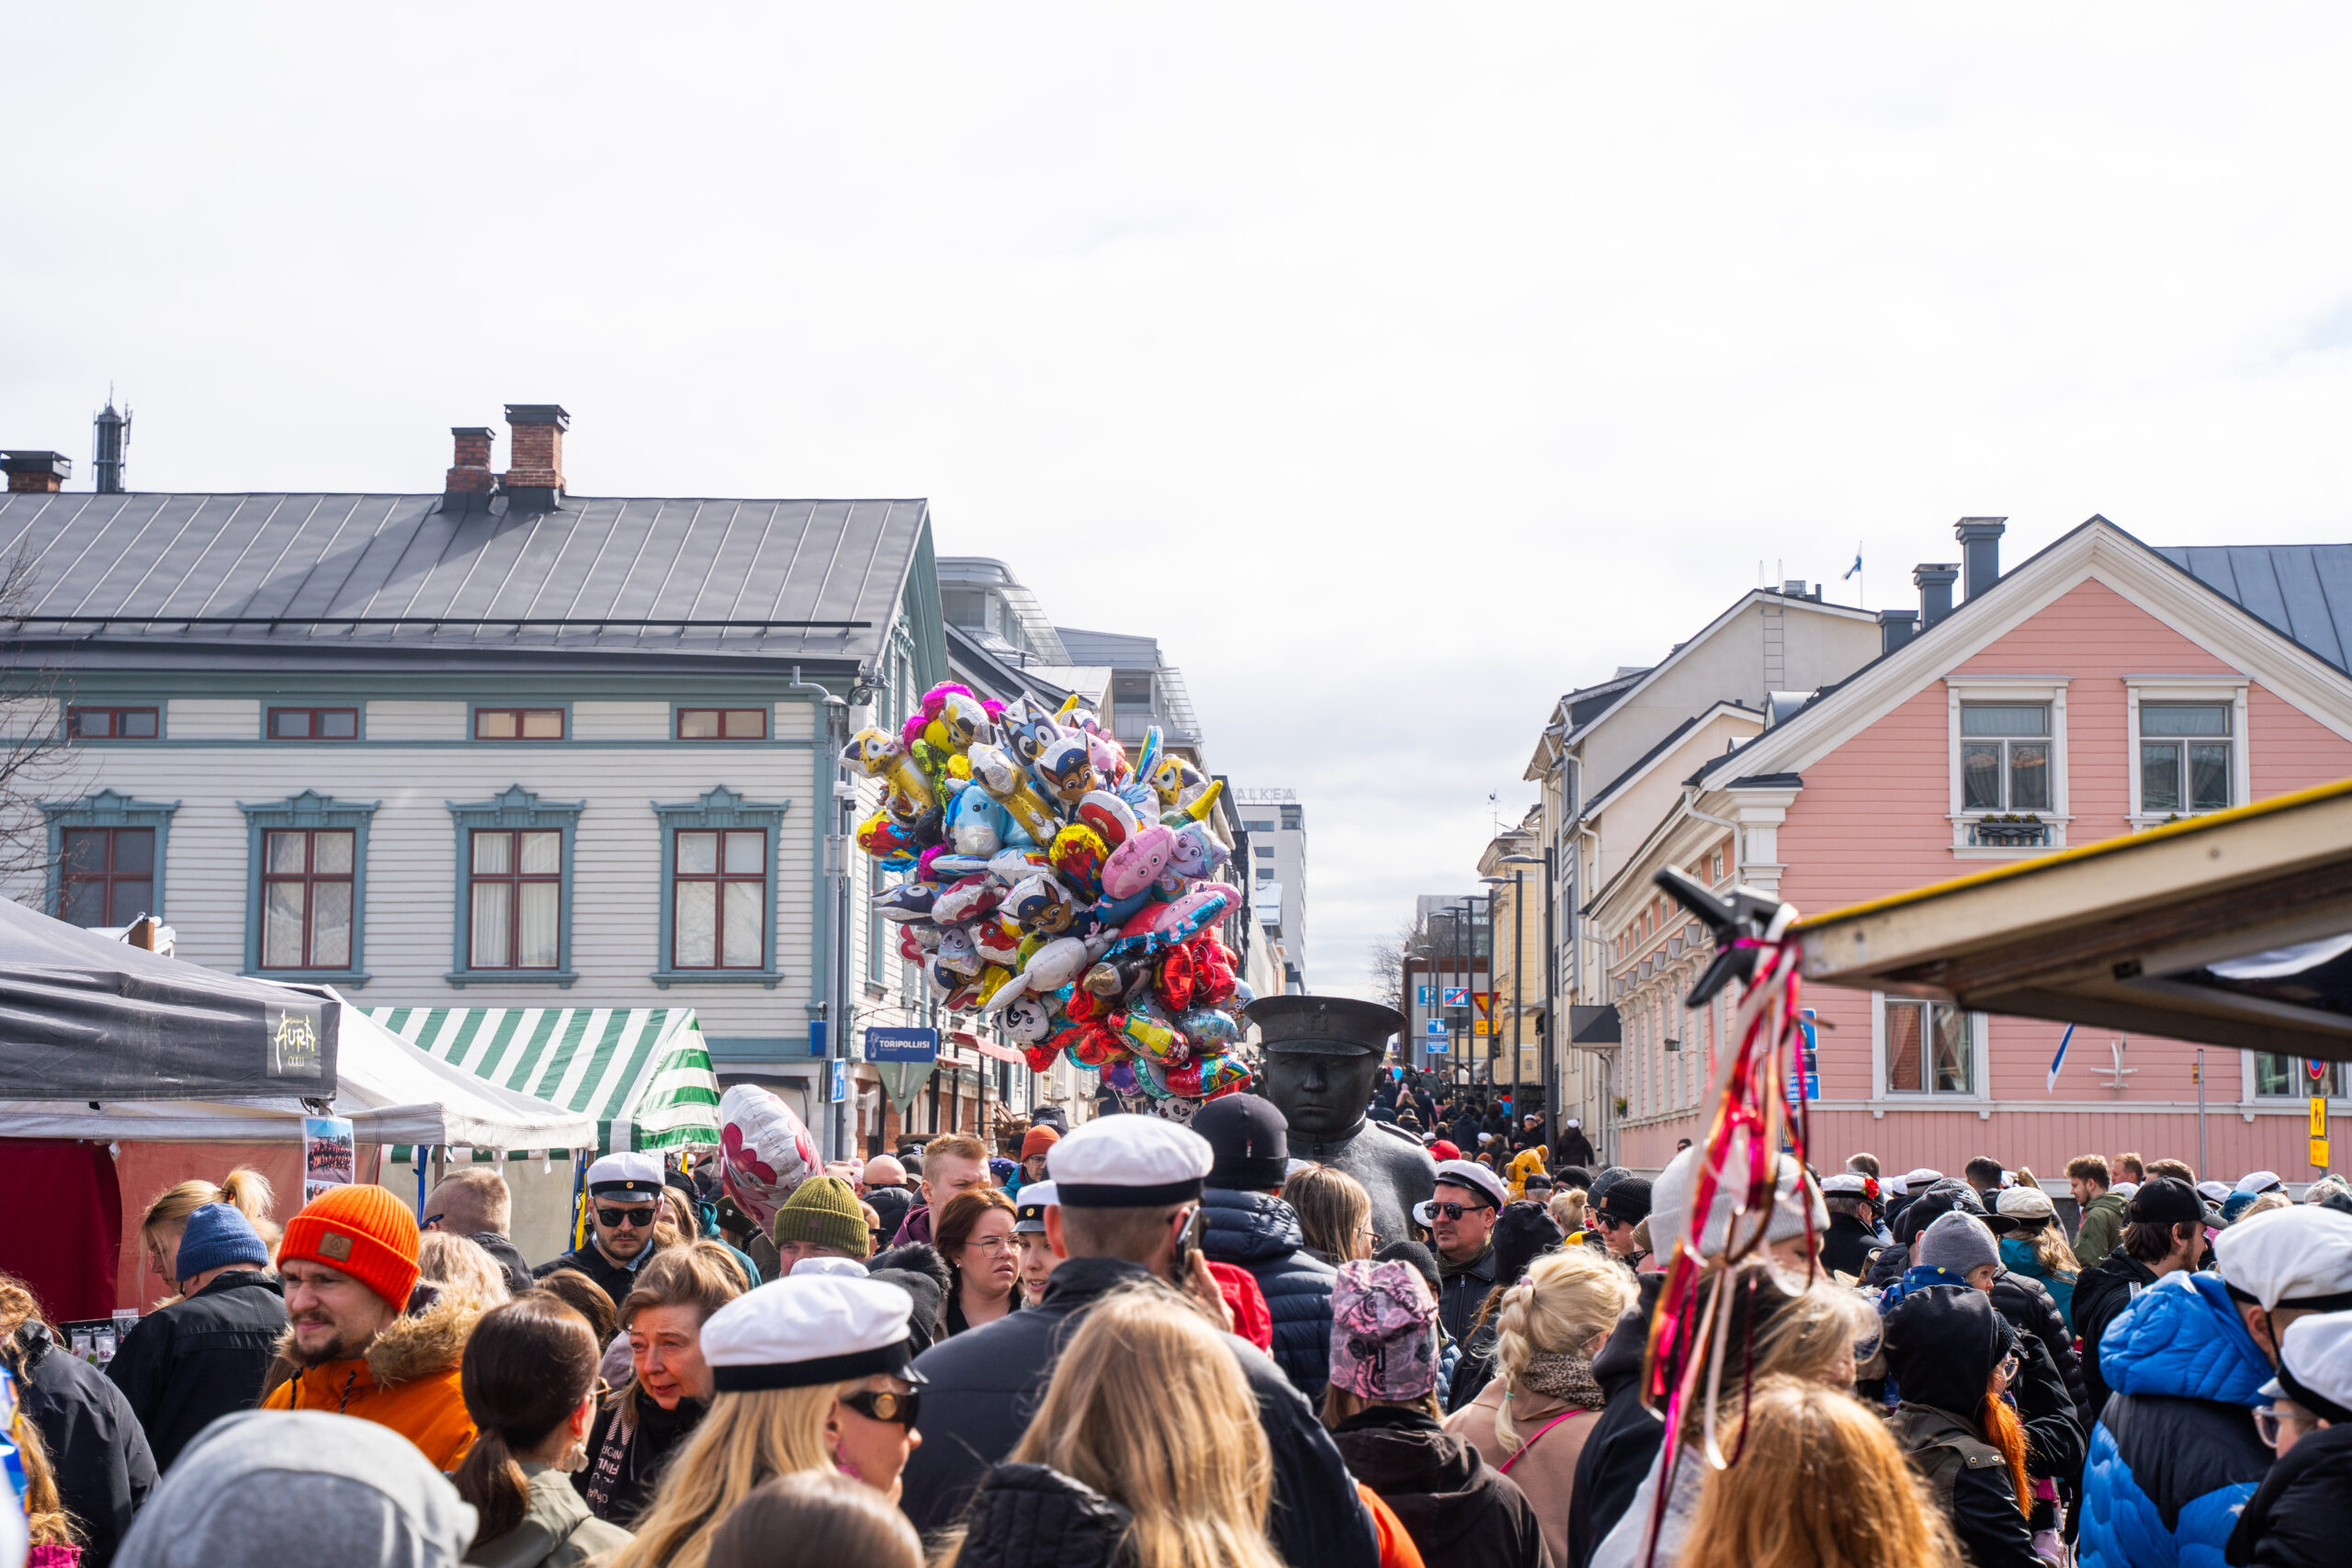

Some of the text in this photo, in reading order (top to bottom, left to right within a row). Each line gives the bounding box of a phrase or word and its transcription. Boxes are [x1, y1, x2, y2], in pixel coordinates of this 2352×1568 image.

[1231, 788, 1296, 800] ALKEA
[274, 1008, 316, 1074] AURA
[879, 1040, 930, 1049] TORIPOLLIISI
